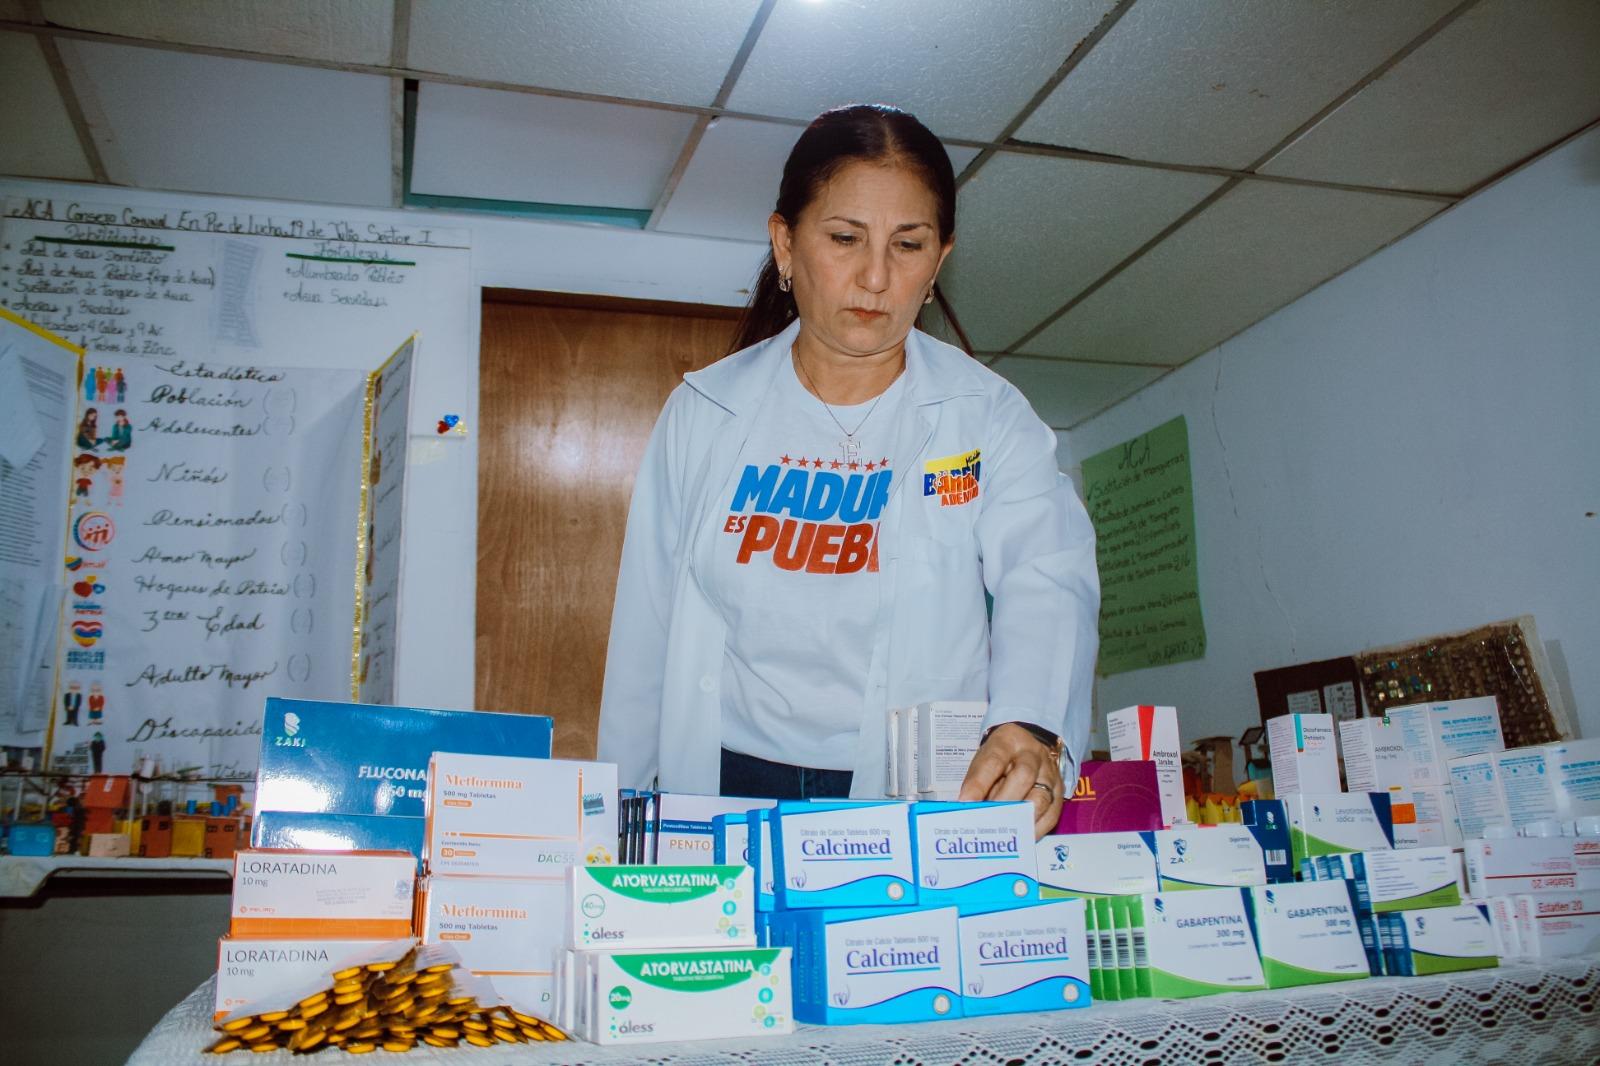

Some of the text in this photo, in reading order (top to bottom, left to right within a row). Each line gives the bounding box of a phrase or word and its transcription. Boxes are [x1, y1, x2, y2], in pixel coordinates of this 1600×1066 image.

[177, 211, 199, 231] En
[306, 220, 325, 239] de
[368, 223, 411, 244] Sector
[724, 515, 747, 533] ES
[669, 838, 714, 851] PENTO
[801, 837, 891, 856] Calcimed
[935, 836, 1018, 855] Calcimed
[243, 861, 338, 875] LORATADINA
[242, 877, 269, 888] 10 mg
[612, 873, 721, 888] ATORVASTATINA
[441, 903, 529, 920] Metformina
[1287, 905, 1348, 919] GABAPENTINA
[440, 922, 498, 932] 500 mg Tabletas
[1177, 915, 1243, 929] GABAPENTINA
[1232, 930, 1245, 939] mg
[979, 935, 1068, 960] Calcimed
[227, 949, 329, 963] LORATADINA
[846, 945, 939, 969] Calcimed
[227, 967, 255, 978] 10 mg
[640, 959, 754, 977] ATORVASTATINA
